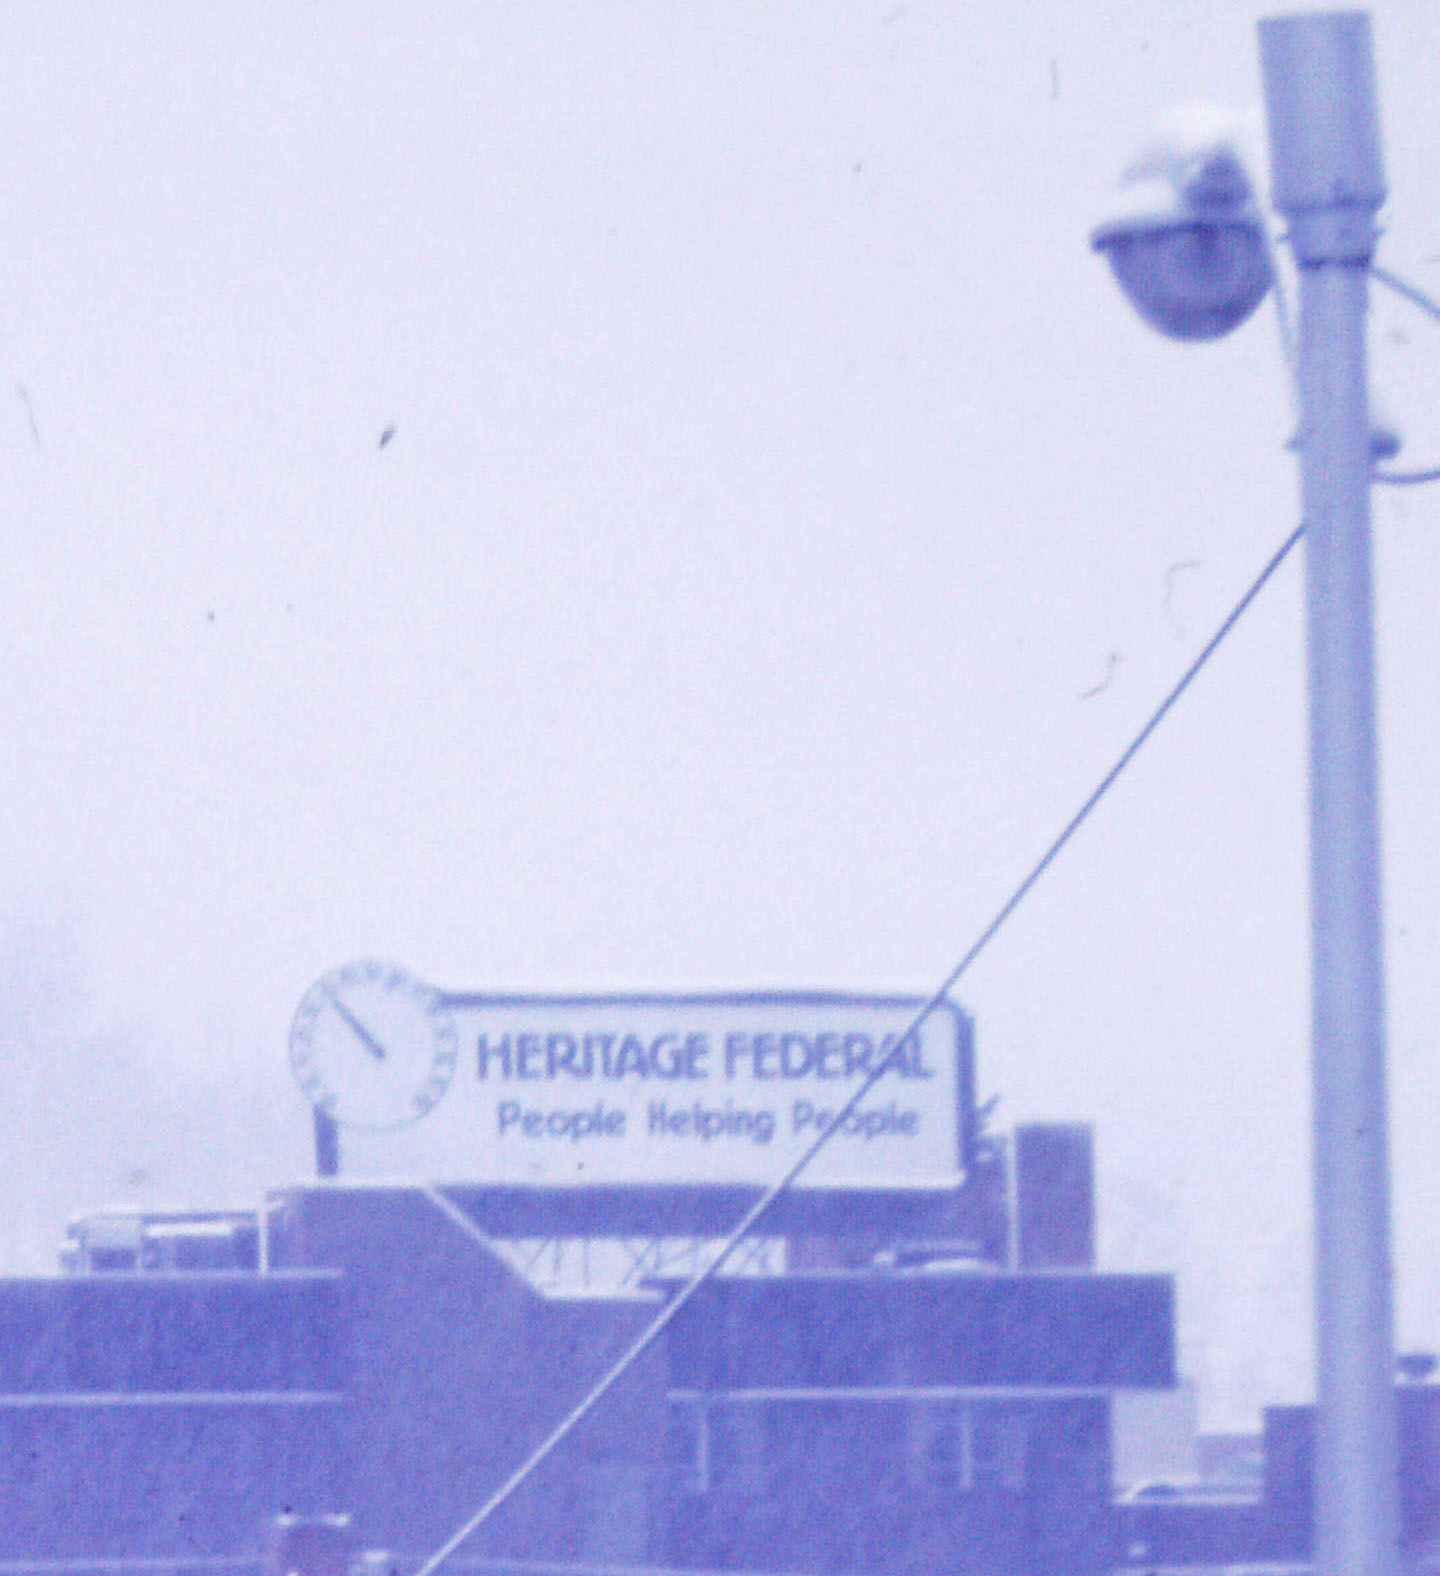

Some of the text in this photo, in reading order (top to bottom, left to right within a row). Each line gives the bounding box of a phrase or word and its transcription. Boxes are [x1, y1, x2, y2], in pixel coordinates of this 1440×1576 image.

[476, 1031, 935, 1081] HERITAGE FEDERAL
[497, 1098, 919, 1143] People Helping People
